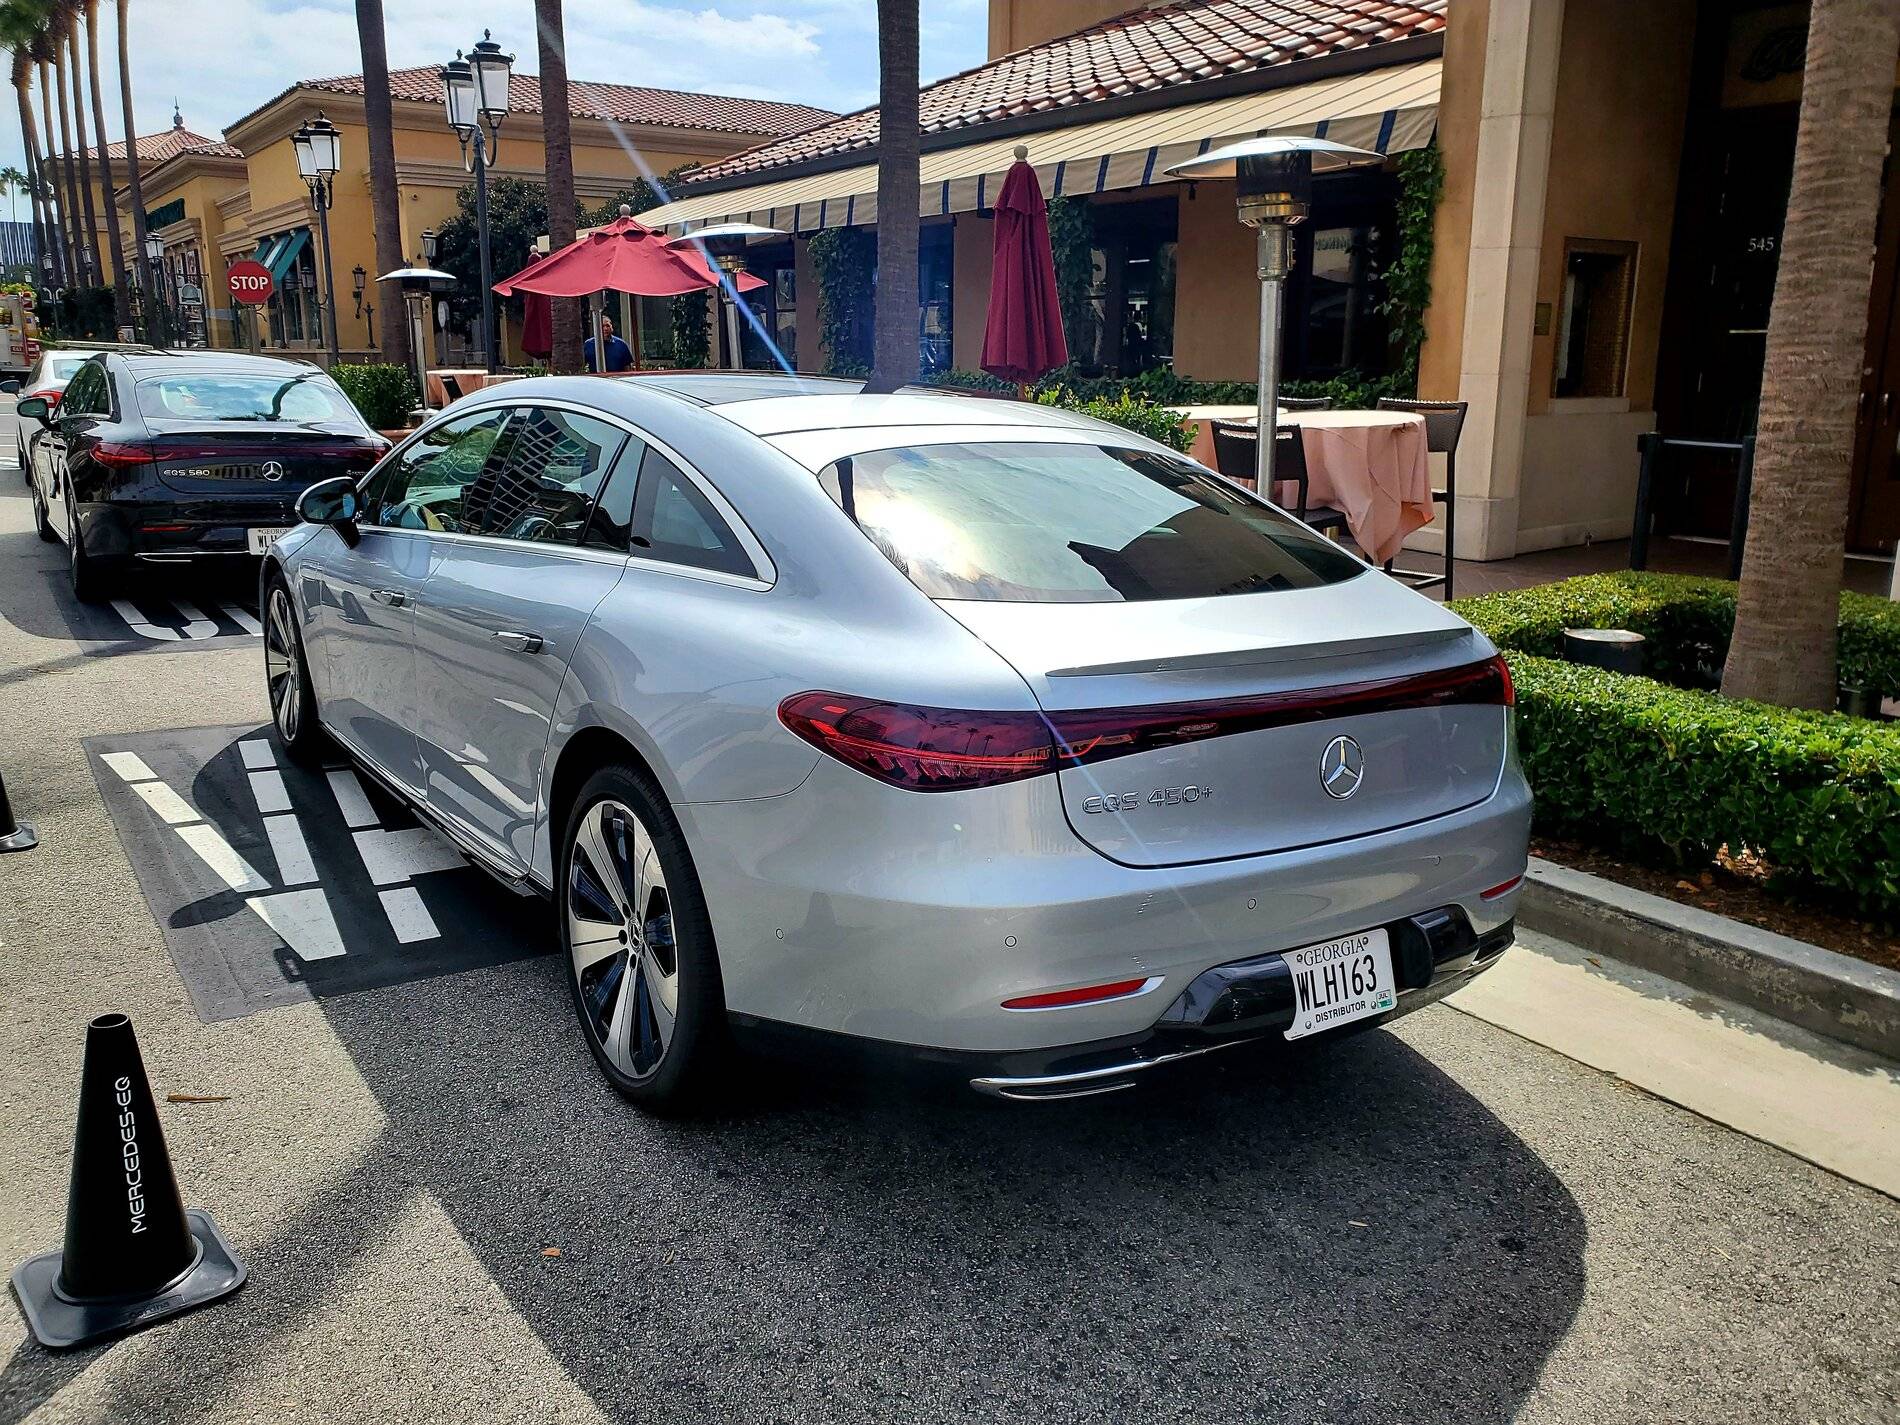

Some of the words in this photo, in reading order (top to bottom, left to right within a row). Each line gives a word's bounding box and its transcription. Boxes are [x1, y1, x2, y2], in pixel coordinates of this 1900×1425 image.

[1748, 236, 1775, 252] 545
[230, 275, 269, 290] STOP
[1082, 791, 1139, 814] EQS
[1147, 784, 1213, 807] 450+
[1303, 937, 1365, 967] GEORGIA
[1296, 954, 1377, 1012] WLH163
[1315, 1000, 1367, 1023] DISTRIBUTOR
[114, 1076, 147, 1234] MERCEDES-EQ
